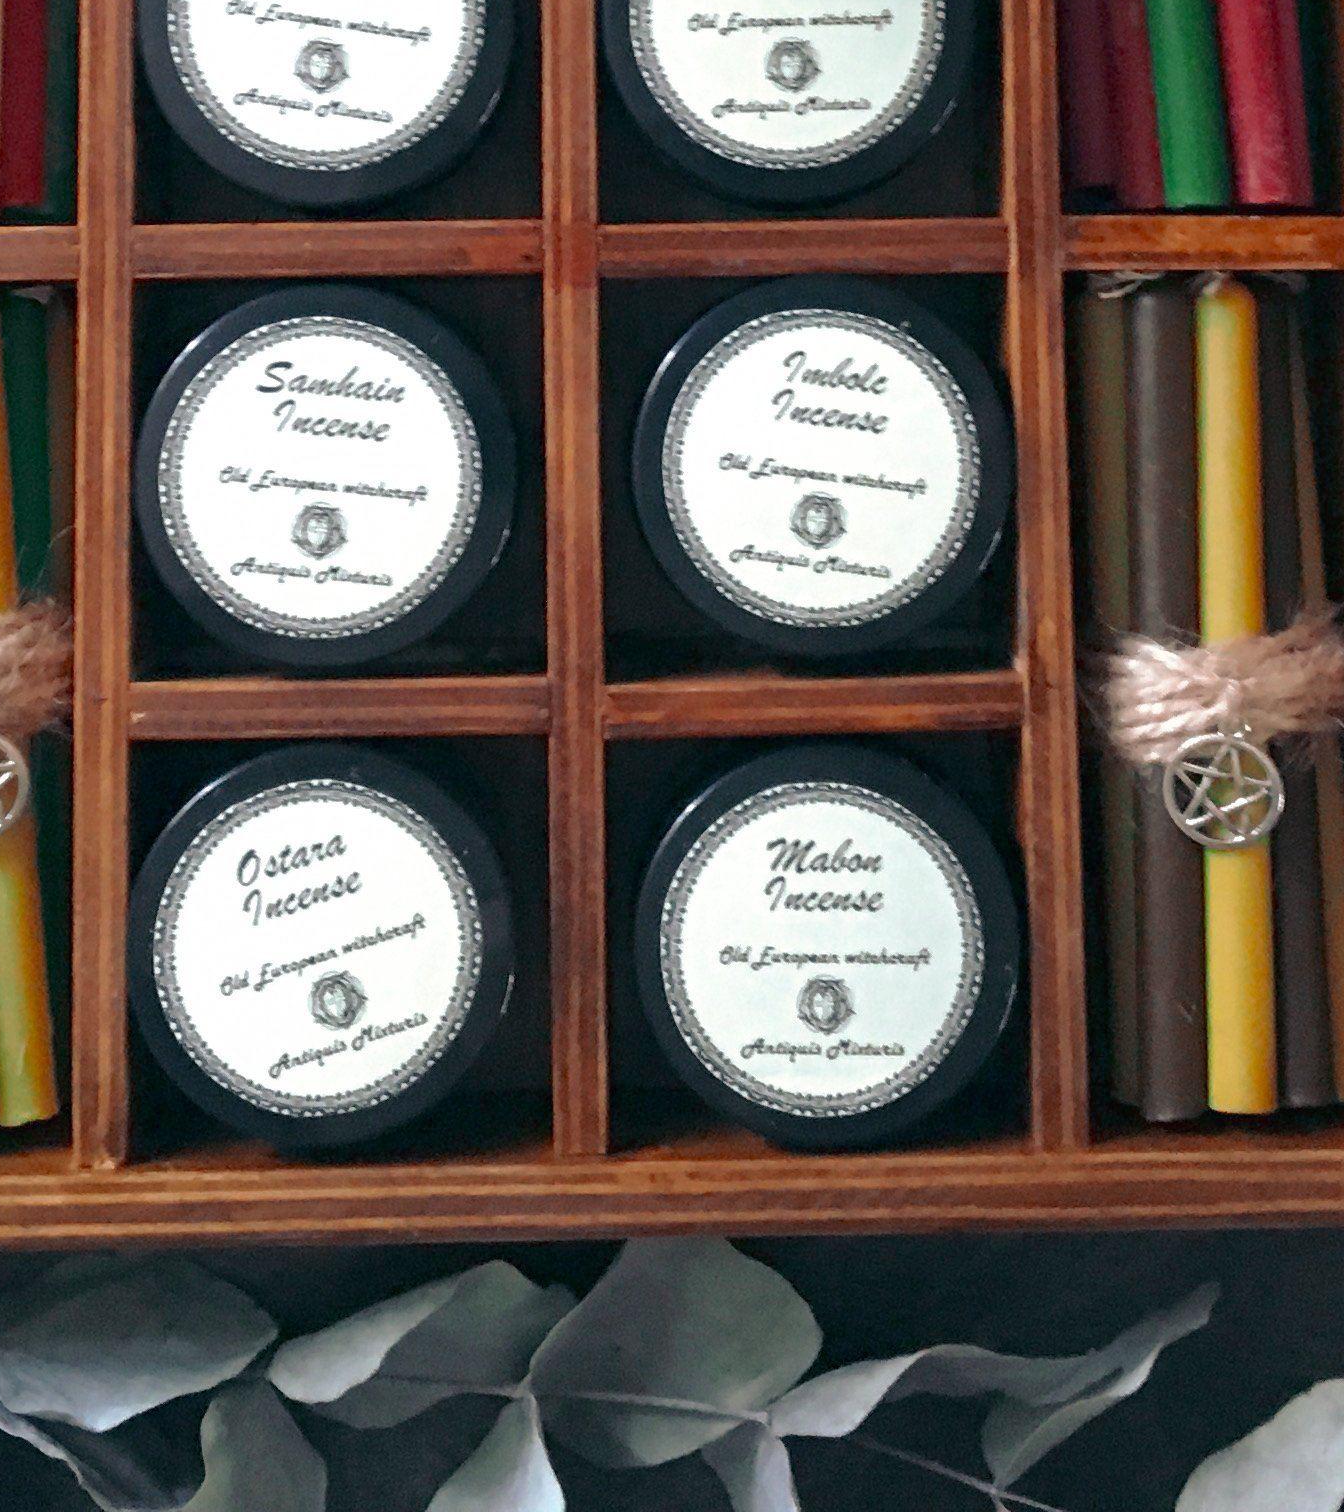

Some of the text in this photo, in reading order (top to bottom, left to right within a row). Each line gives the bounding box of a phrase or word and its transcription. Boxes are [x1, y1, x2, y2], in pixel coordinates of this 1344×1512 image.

[256, 360, 406, 402] Samhain
[783, 350, 889, 394] Imbolc
[273, 399, 391, 441] Incense
[772, 388, 889, 433] Incense
[237, 835, 347, 886] Ostara
[767, 837, 883, 873] Mabon
[242, 872, 363, 926] Incense
[764, 875, 884, 912] Incense
[220, 970, 249, 996] Old
[254, 949, 337, 991] European
[719, 945, 751, 964] Old
[751, 946, 839, 970] European
